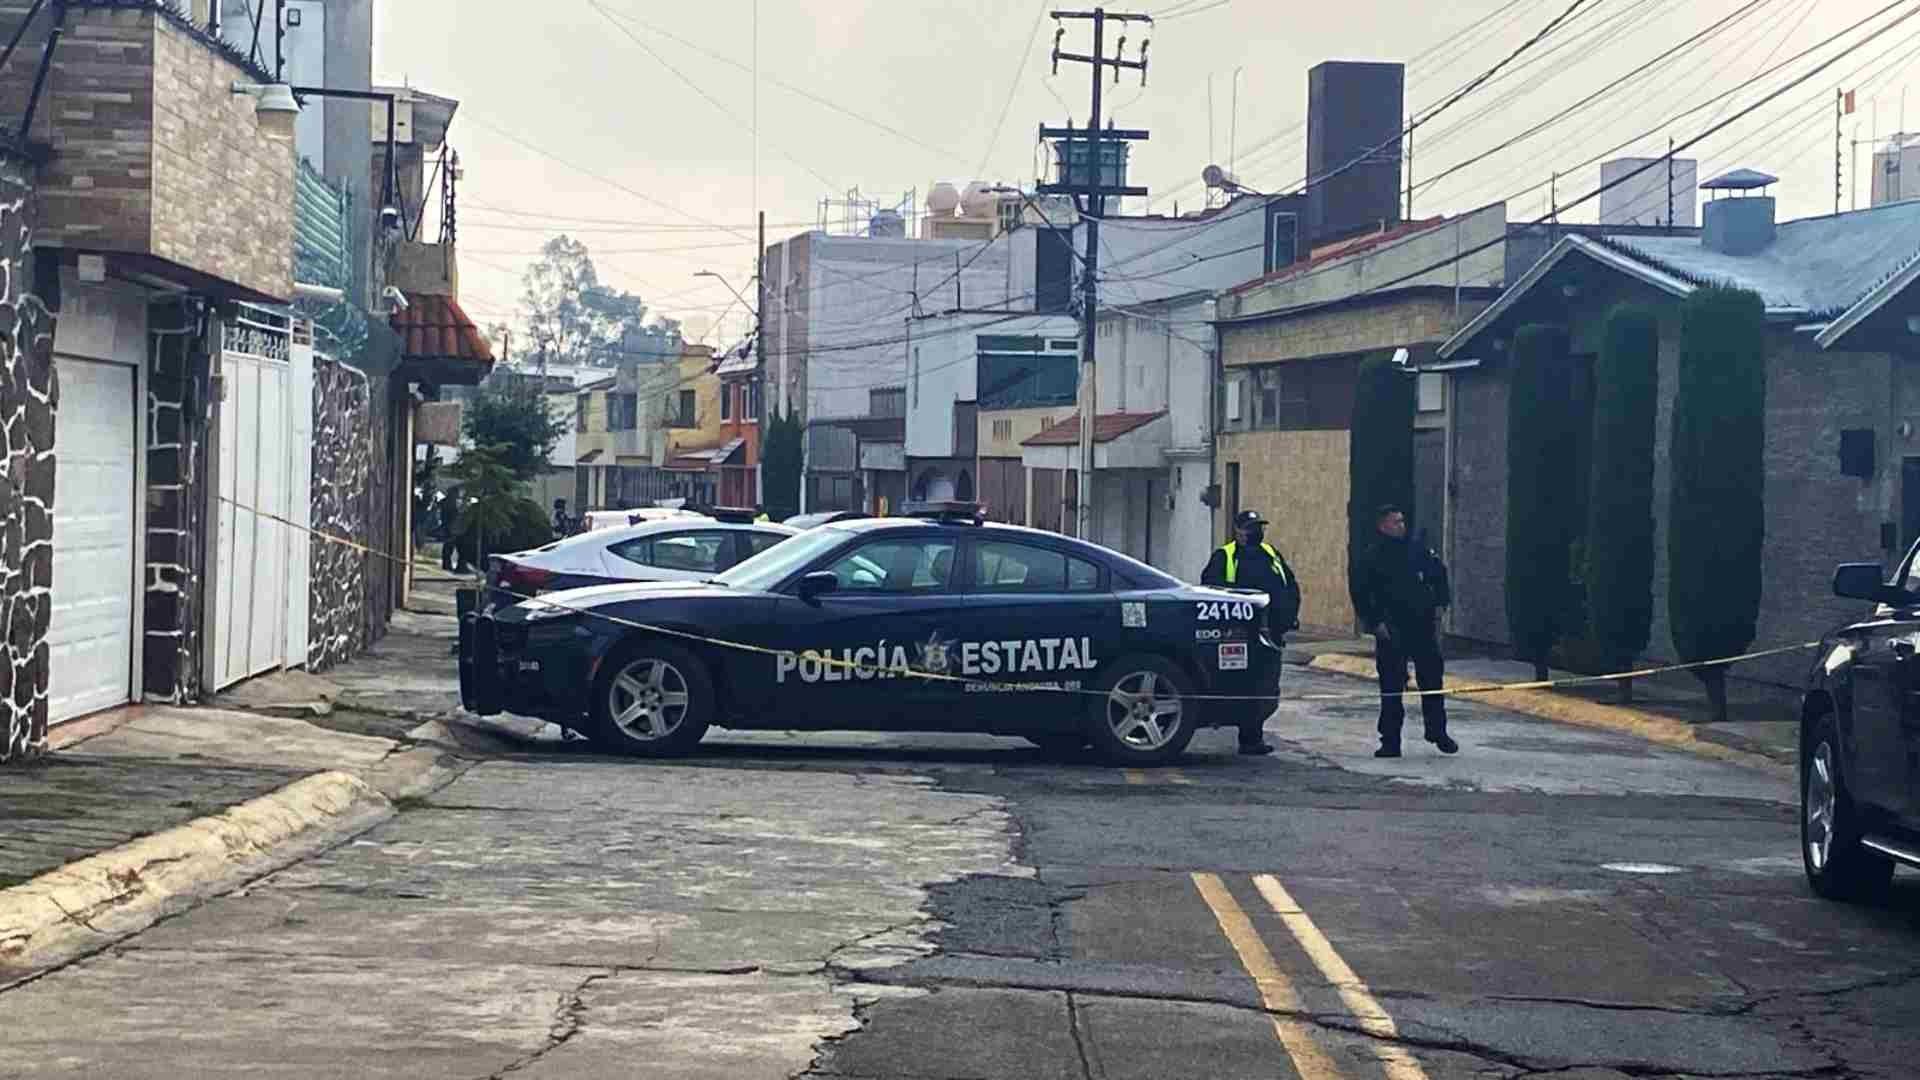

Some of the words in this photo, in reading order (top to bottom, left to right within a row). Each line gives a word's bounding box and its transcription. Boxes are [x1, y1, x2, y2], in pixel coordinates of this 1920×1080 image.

[1196, 602, 1254, 620] 24140
[776, 639, 910, 683] POLICÍA
[962, 637, 1098, 675] ESTATAL
